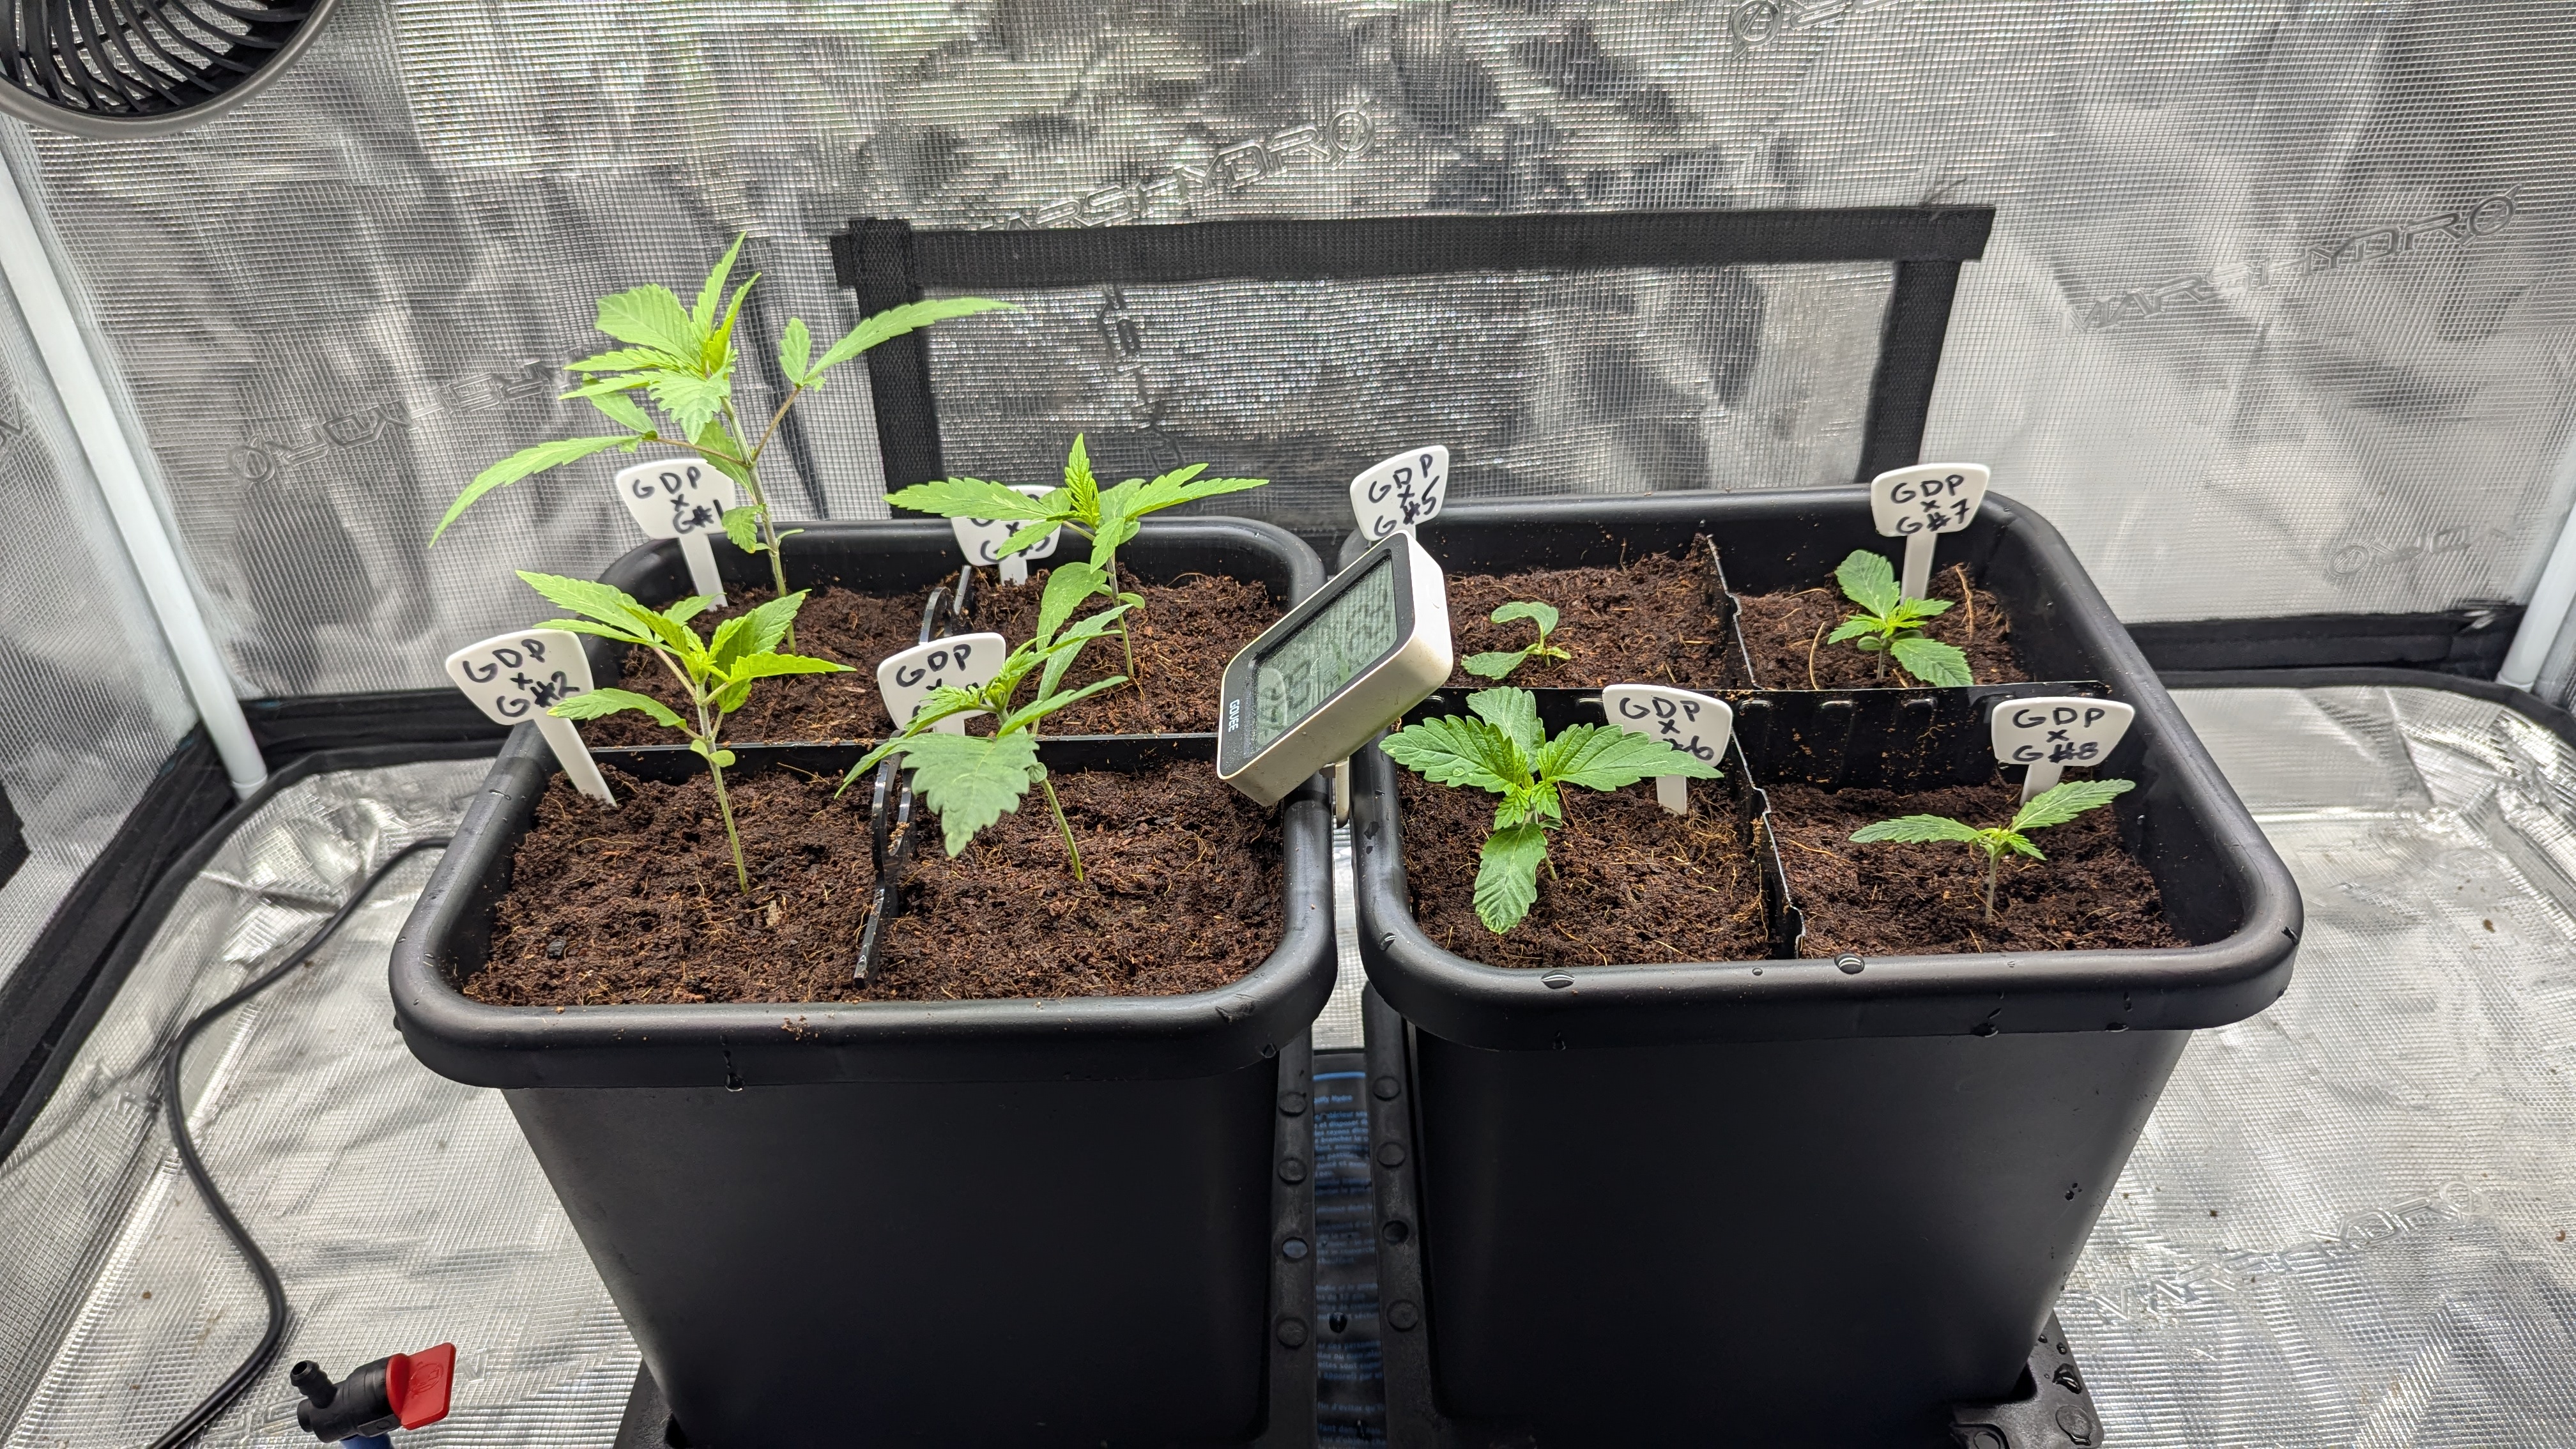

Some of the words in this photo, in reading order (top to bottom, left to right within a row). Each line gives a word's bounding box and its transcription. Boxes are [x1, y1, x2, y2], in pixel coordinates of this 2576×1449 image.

[632, 466, 702, 499] GDP
[1368, 454, 1433, 503] GDP
[1890, 474, 1964, 504] GDP
[463, 639, 546, 683] GDP
[896, 643, 972, 687] GDP
[1228, 699, 1240, 733] GOVEE
[1619, 696, 1700, 723] GDP
[2012, 707, 2105, 728] GDP
